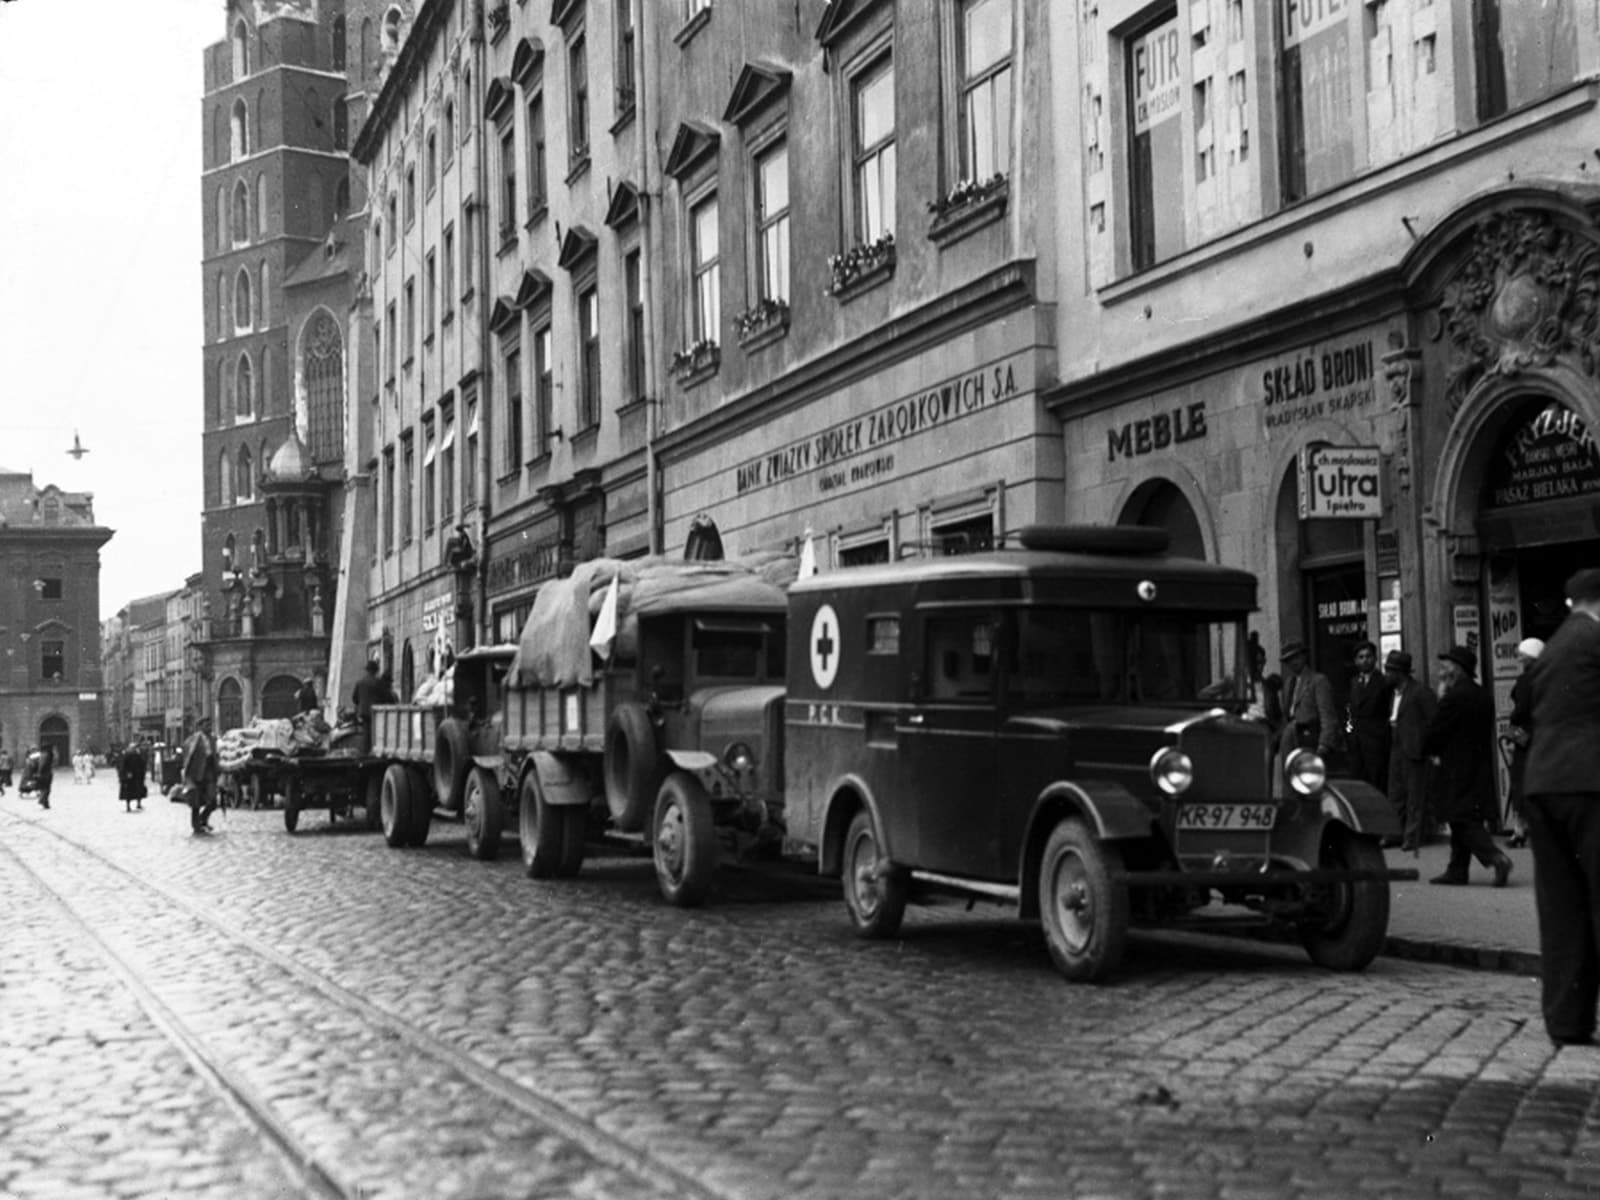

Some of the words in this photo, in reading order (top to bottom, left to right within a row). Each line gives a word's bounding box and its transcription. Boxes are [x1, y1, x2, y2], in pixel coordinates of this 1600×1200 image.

[1264, 359, 1316, 406] SKŁAD
[1322, 340, 1374, 392] BRONI
[868, 373, 985, 446] ZAROBKOWYCH
[1107, 400, 1208, 462] MEBLE
[1240, 806, 1273, 827] 948
